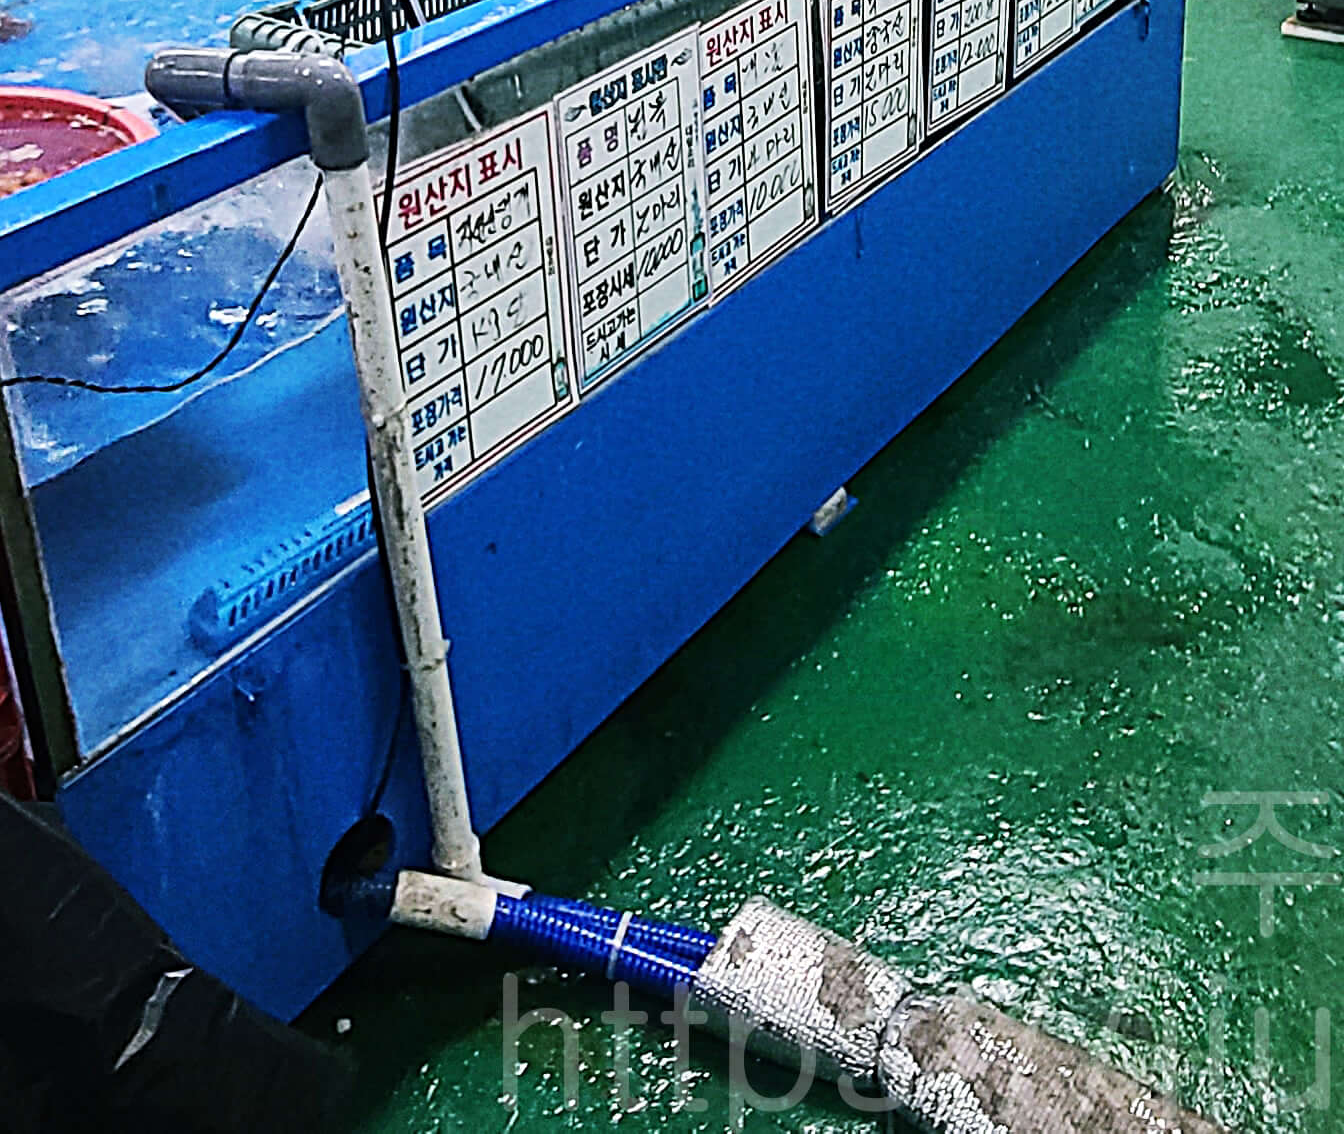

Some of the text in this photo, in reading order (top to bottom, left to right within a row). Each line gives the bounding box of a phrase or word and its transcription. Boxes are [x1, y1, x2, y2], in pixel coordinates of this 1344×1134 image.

[706, 15, 755, 67] 원산지
[705, 113, 743, 155] 원산지
[398, 137, 524, 228] 원산지 표시
[578, 170, 626, 221] 원산지
[399, 283, 455, 337] 원산지
[582, 261, 636, 317] 포장시세
[411, 384, 463, 437] 포장가격
